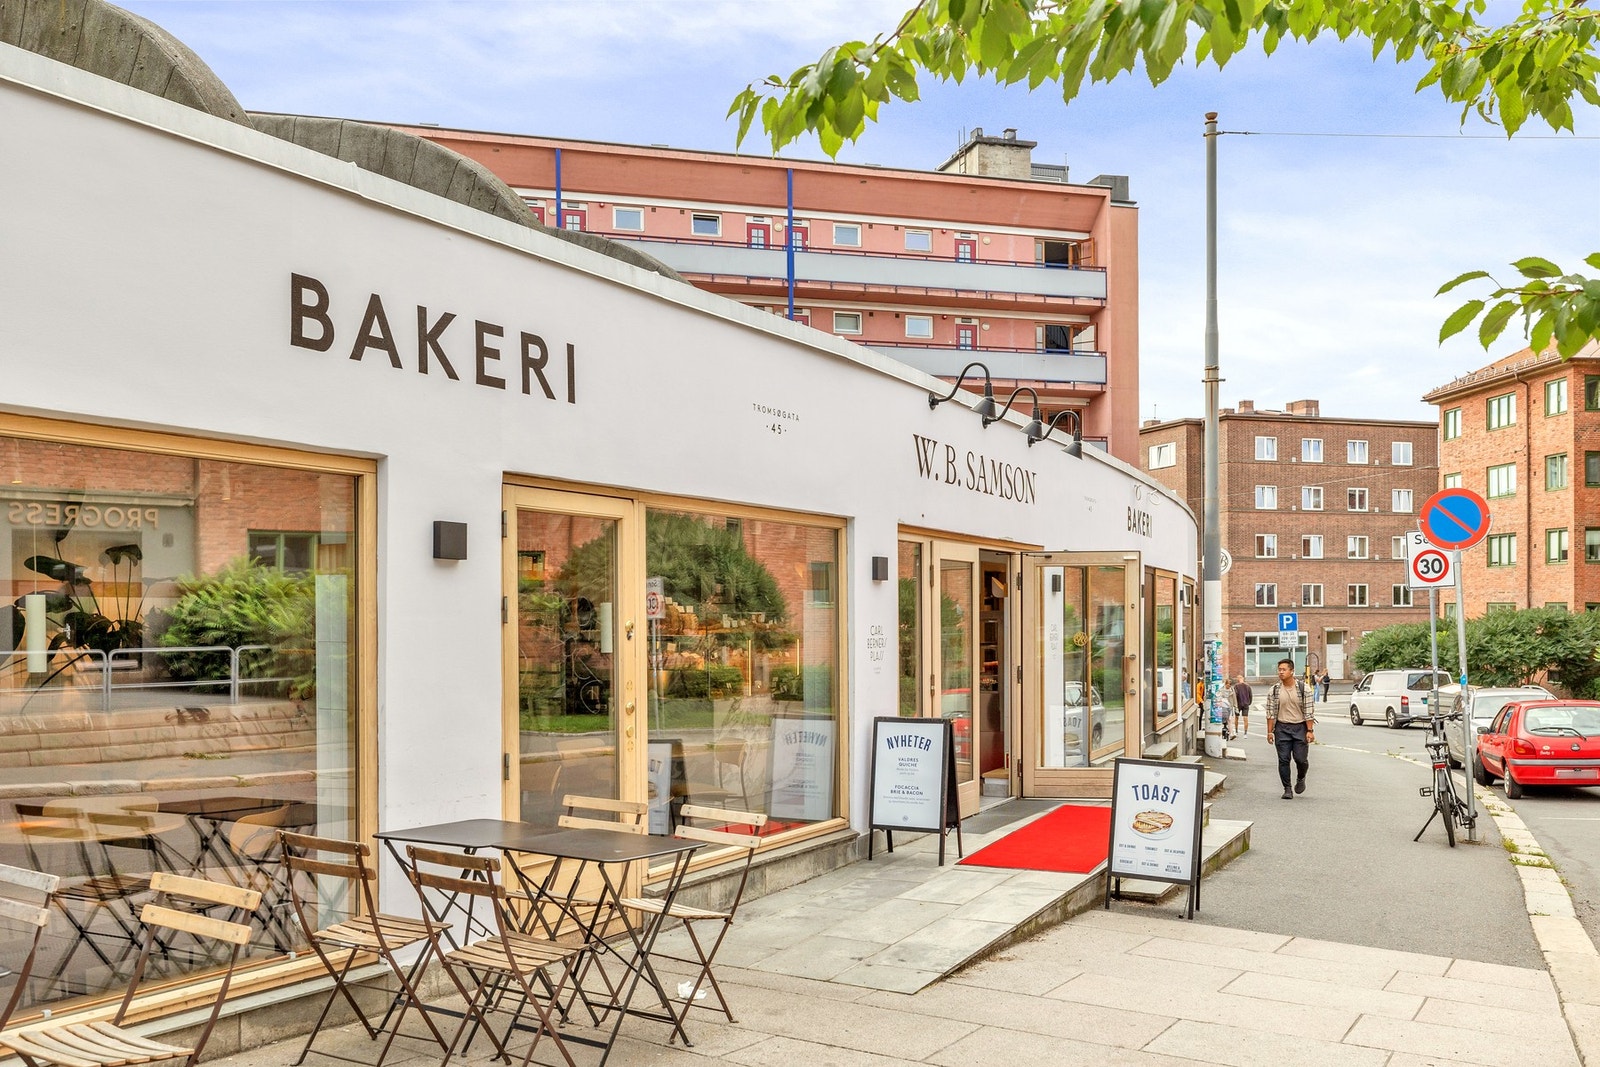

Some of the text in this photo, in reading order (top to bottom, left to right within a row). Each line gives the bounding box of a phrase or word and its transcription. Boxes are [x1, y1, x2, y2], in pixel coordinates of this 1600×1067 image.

[290, 272, 576, 404] BAKERI
[913, 434, 1037, 505] W. B. SAMSON
[1127, 505, 1153, 539] BAKERI
[1420, 557, 1443, 575] 30
[1283, 615, 1293, 629] P
[886, 734, 932, 752] NYHETER
[1132, 784, 1180, 805] TOAST
